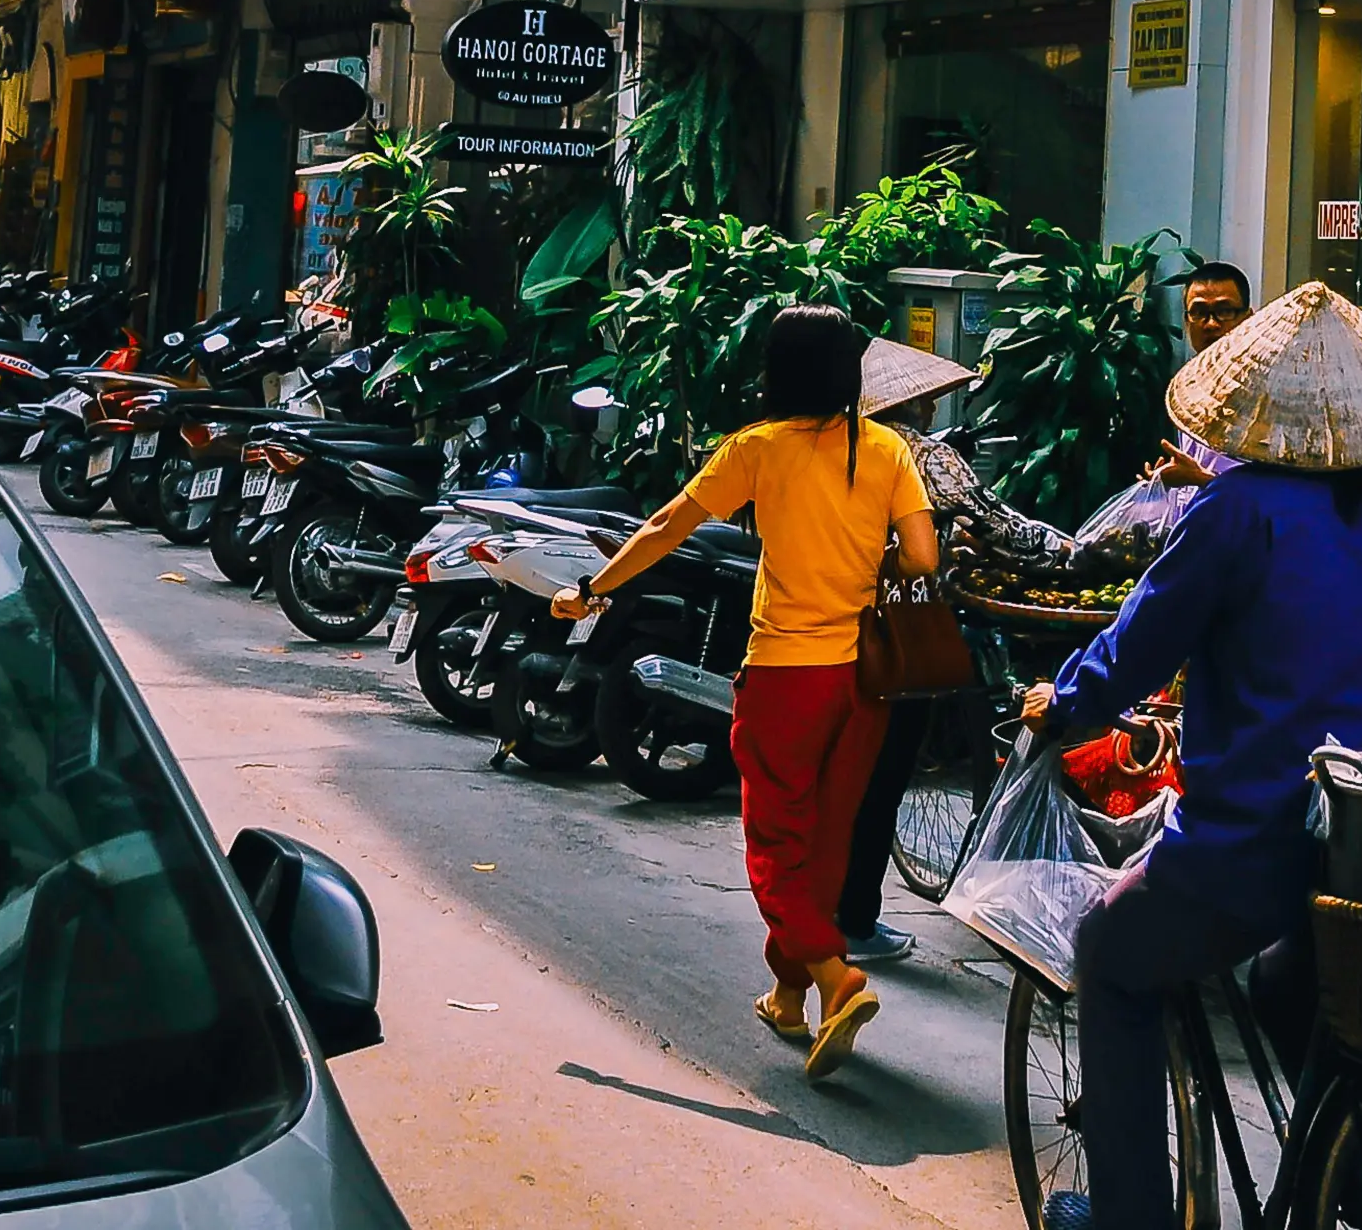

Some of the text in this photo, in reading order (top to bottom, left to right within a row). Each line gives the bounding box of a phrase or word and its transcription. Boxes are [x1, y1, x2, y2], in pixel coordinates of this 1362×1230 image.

[457, 37, 607, 68] HANOI GORTAGE
[457, 136, 595, 158] TOUR INFORMATION
